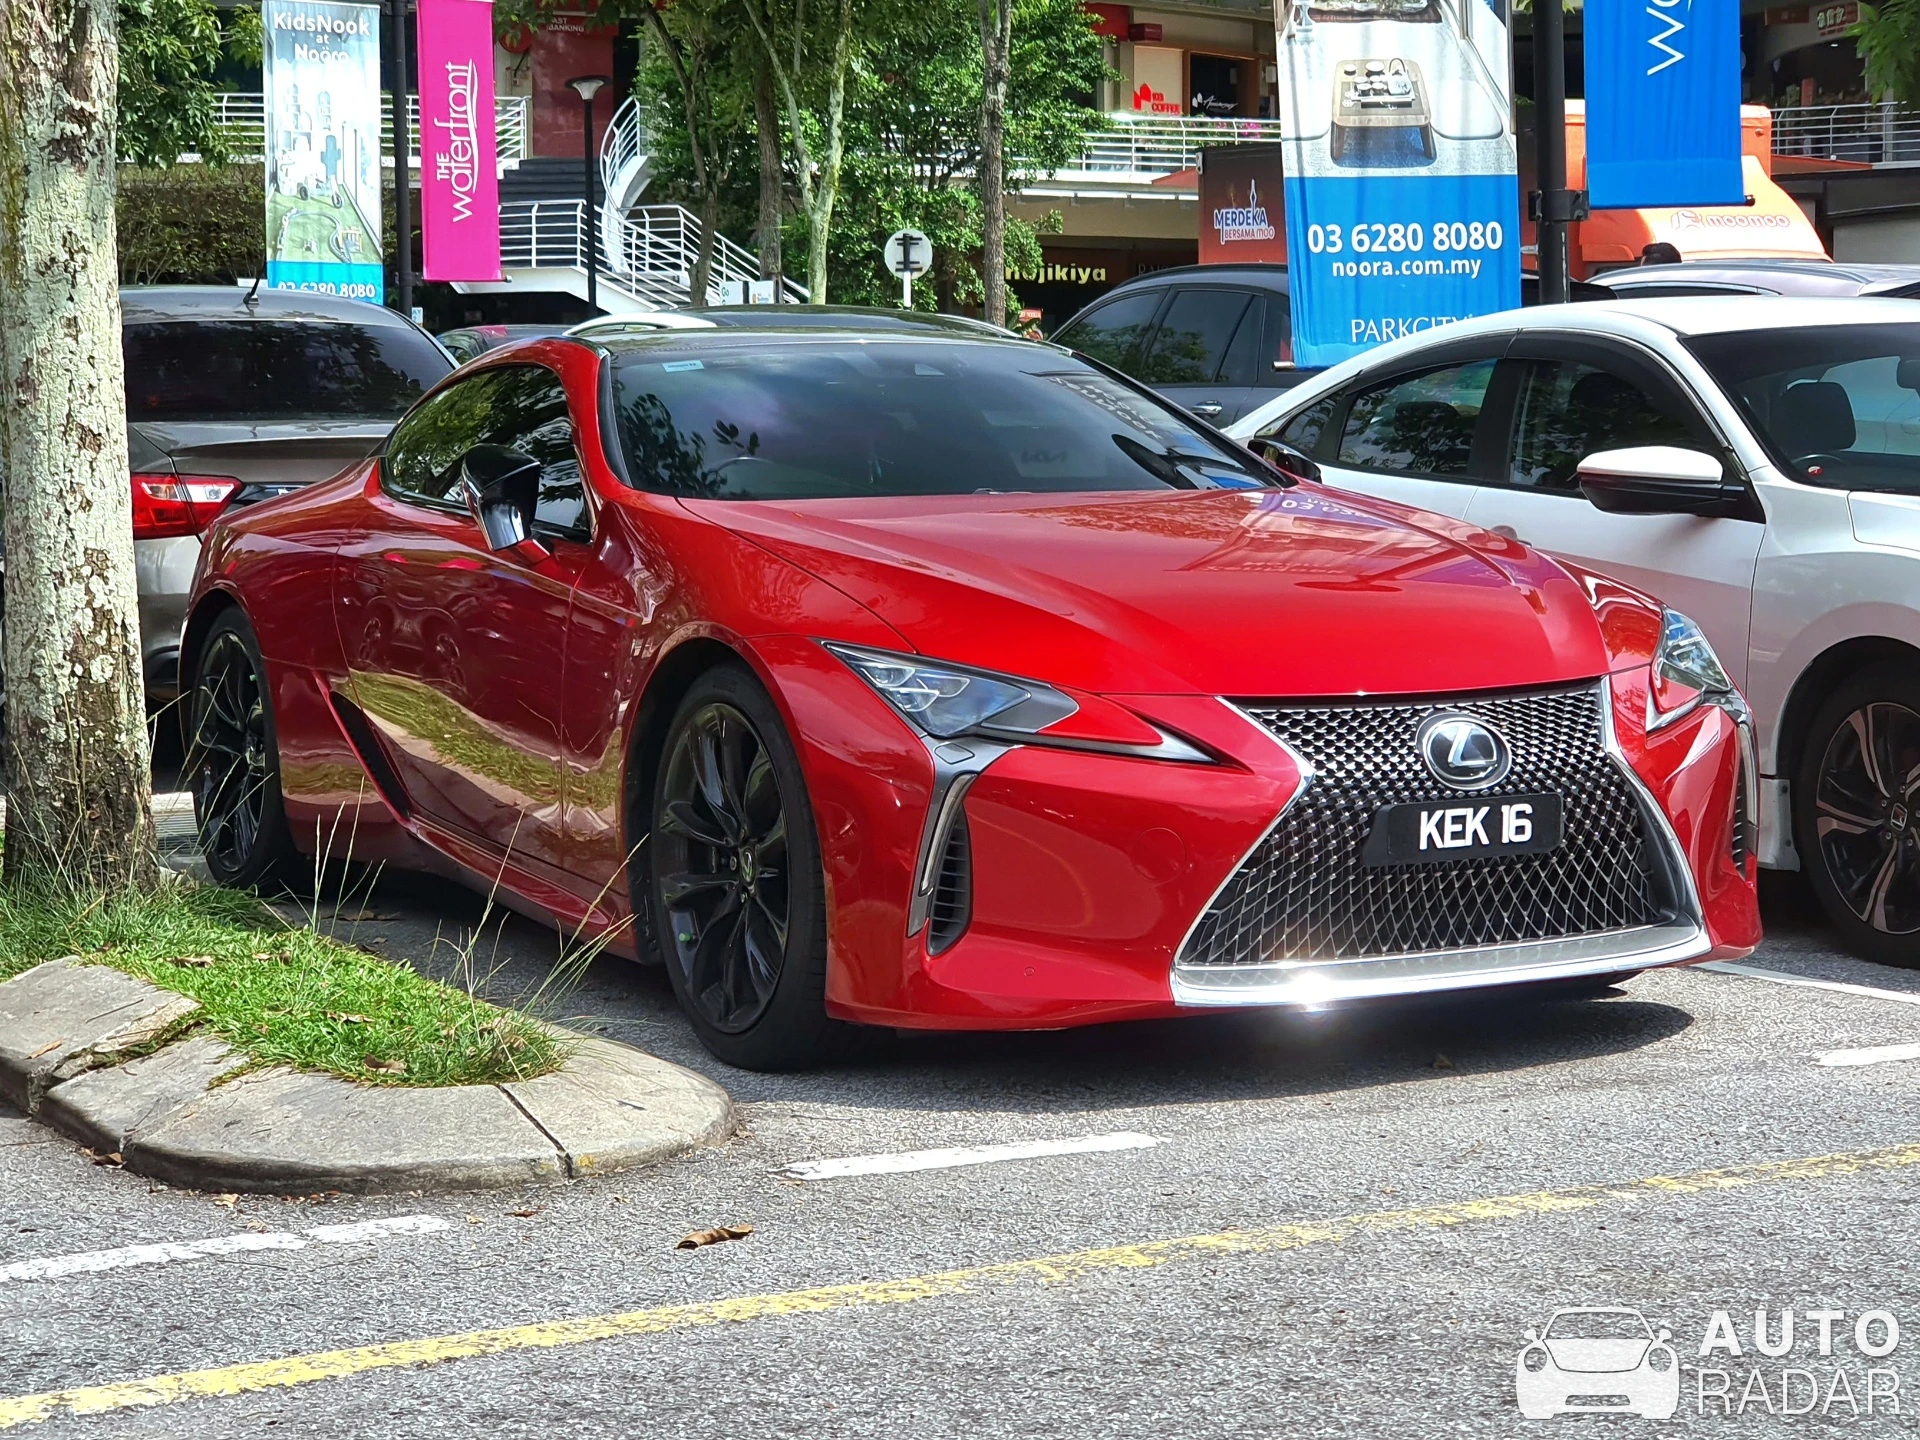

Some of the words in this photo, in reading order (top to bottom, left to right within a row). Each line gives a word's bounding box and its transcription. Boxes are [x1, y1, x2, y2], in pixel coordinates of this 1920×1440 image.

[273, 10, 371, 36] KidsNook
[315, 33, 330, 44] at
[1151, 103, 1181, 115] COFFEE
[433, 60, 474, 223] waterfront
[436, 151, 451, 182] THE
[1214, 208, 1268, 231] MERDEKA
[1705, 214, 1790, 228] moomoo
[1224, 229, 1256, 239] BERSAMA
[1307, 224, 1343, 254] 03
[1351, 222, 1424, 253] 6280
[1433, 221, 1503, 251] 8080
[1332, 258, 1482, 279] noora.com.my
[340, 283, 376, 298] 8080
[1419, 806, 1490, 850] KEK
[1501, 803, 1533, 844] 16
